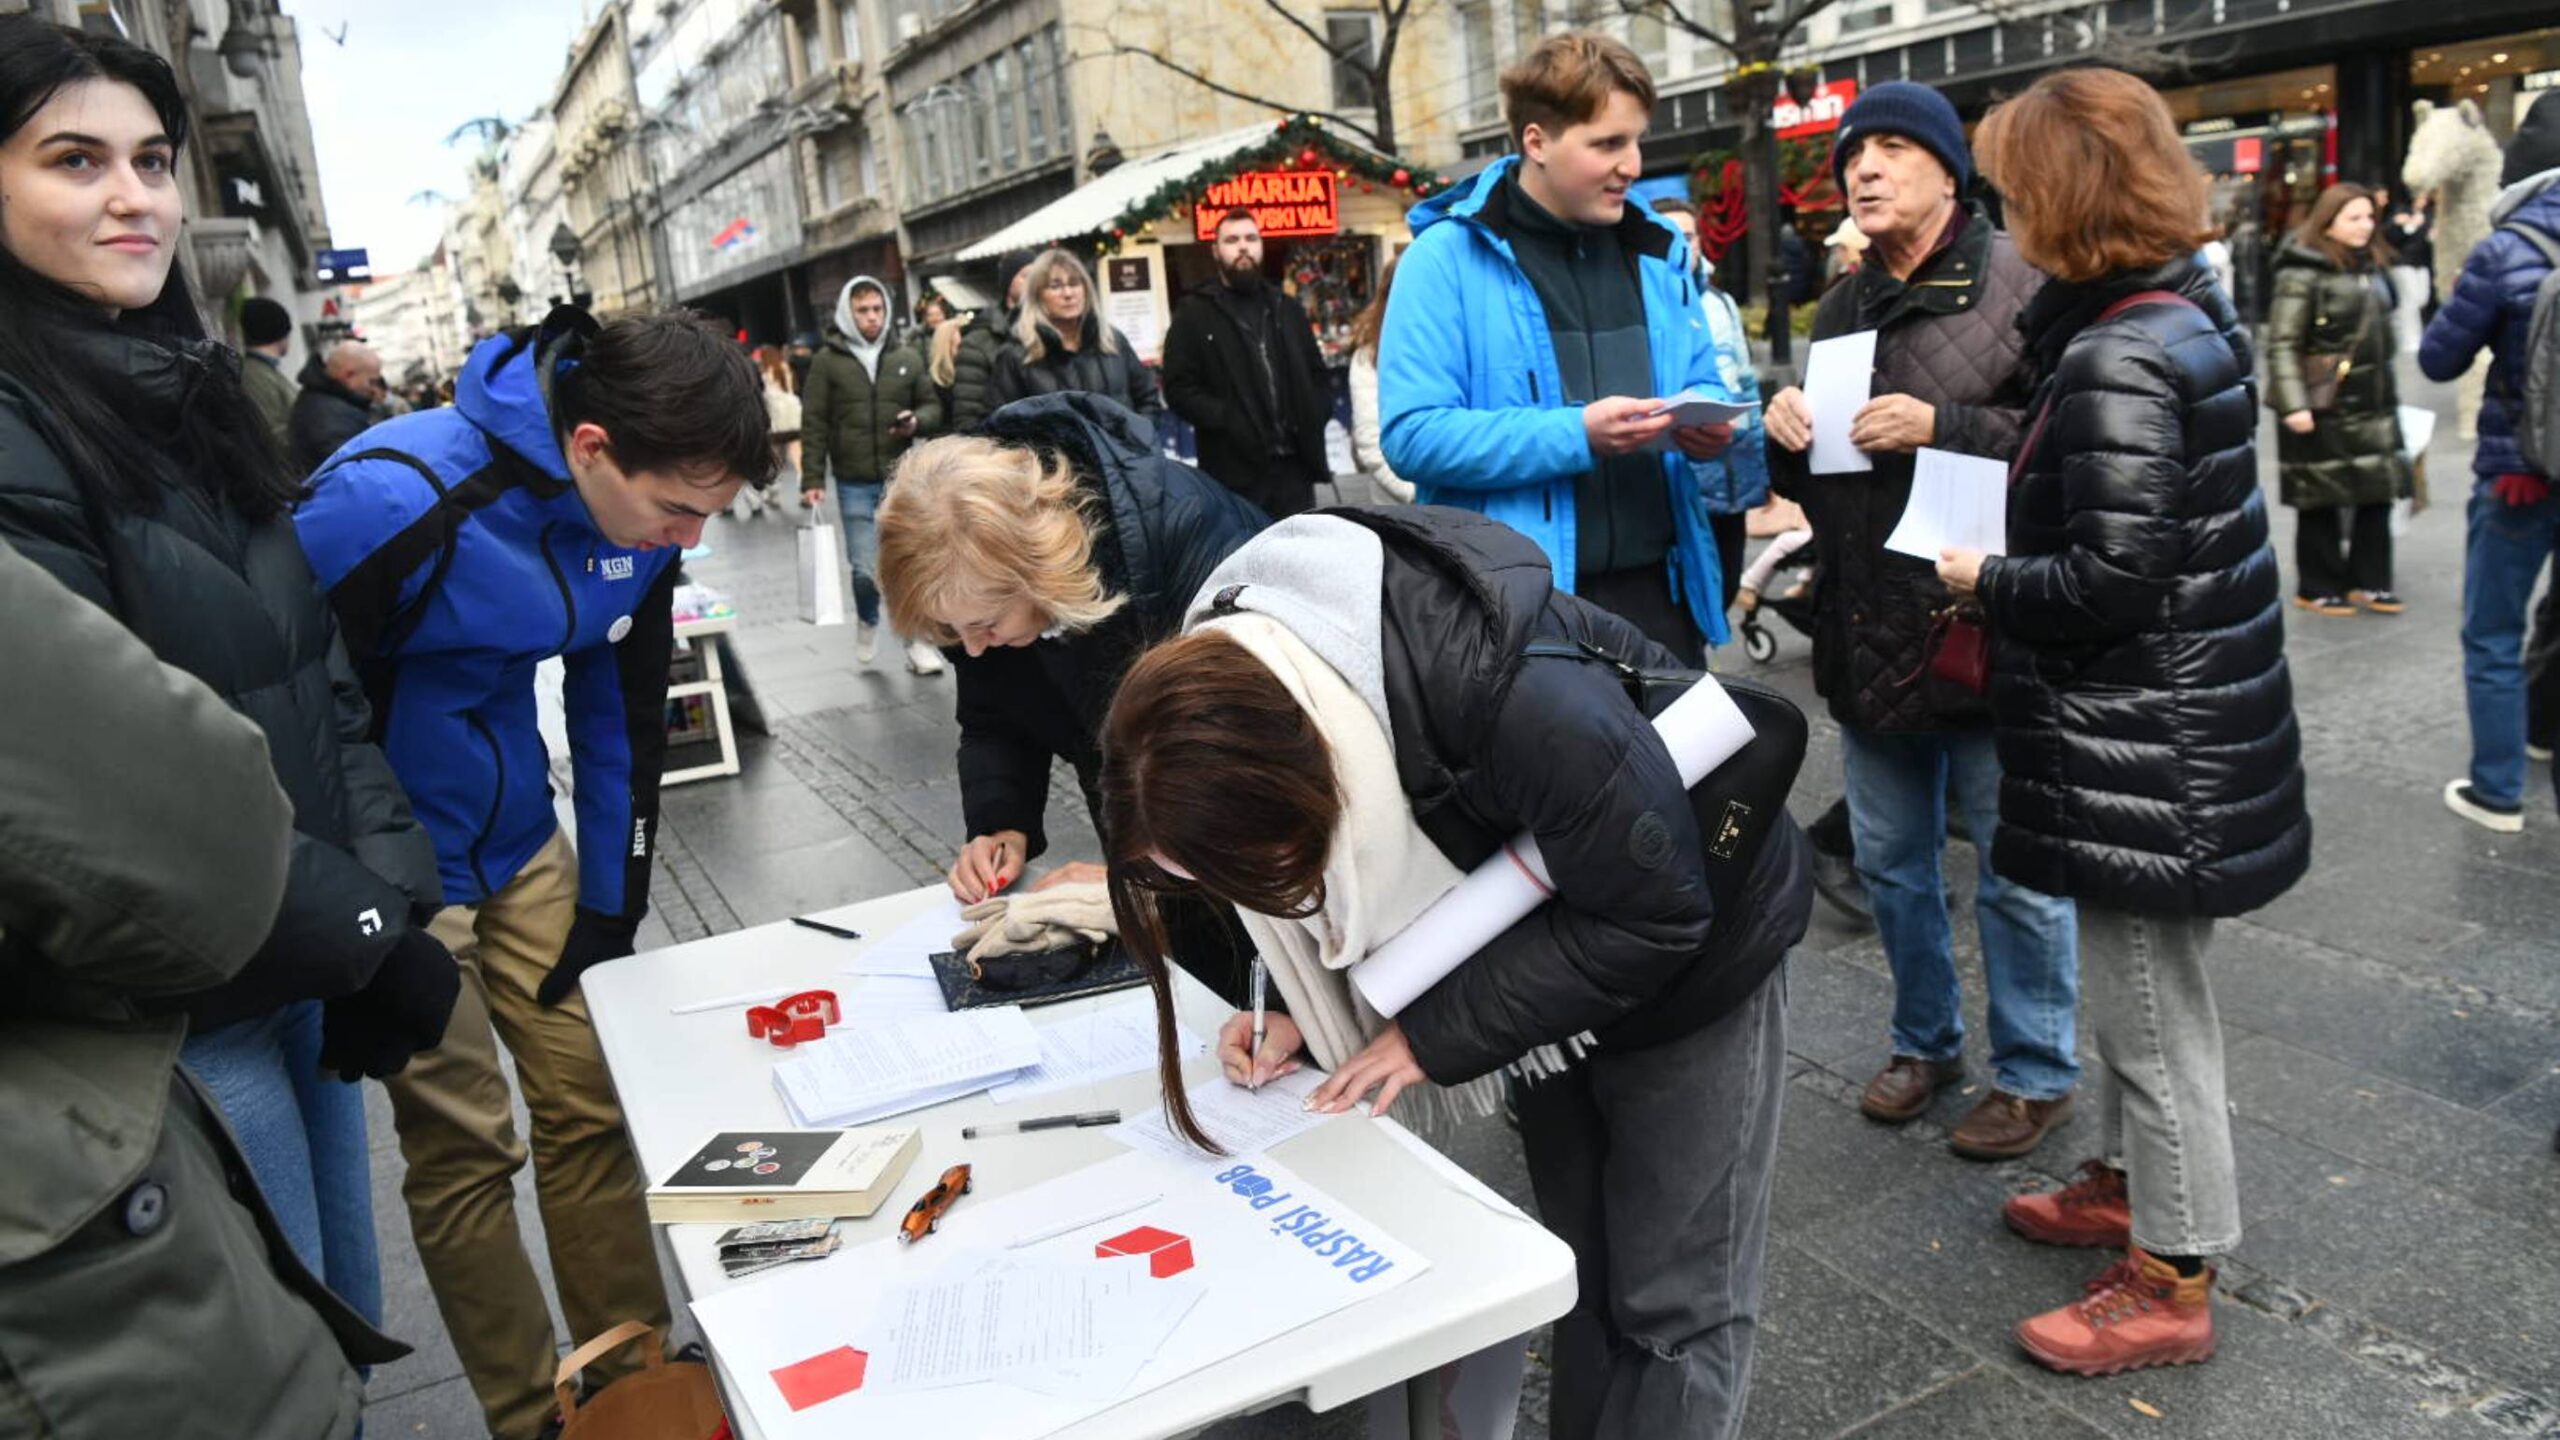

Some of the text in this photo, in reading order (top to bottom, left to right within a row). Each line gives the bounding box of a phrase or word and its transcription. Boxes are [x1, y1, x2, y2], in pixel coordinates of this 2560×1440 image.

[1207, 176, 1326, 206] VINARIJA
[1298, 206, 1333, 227] VAL
[600, 555, 633, 576] NGN
[1270, 1204, 1394, 1283] RASPIŠI
